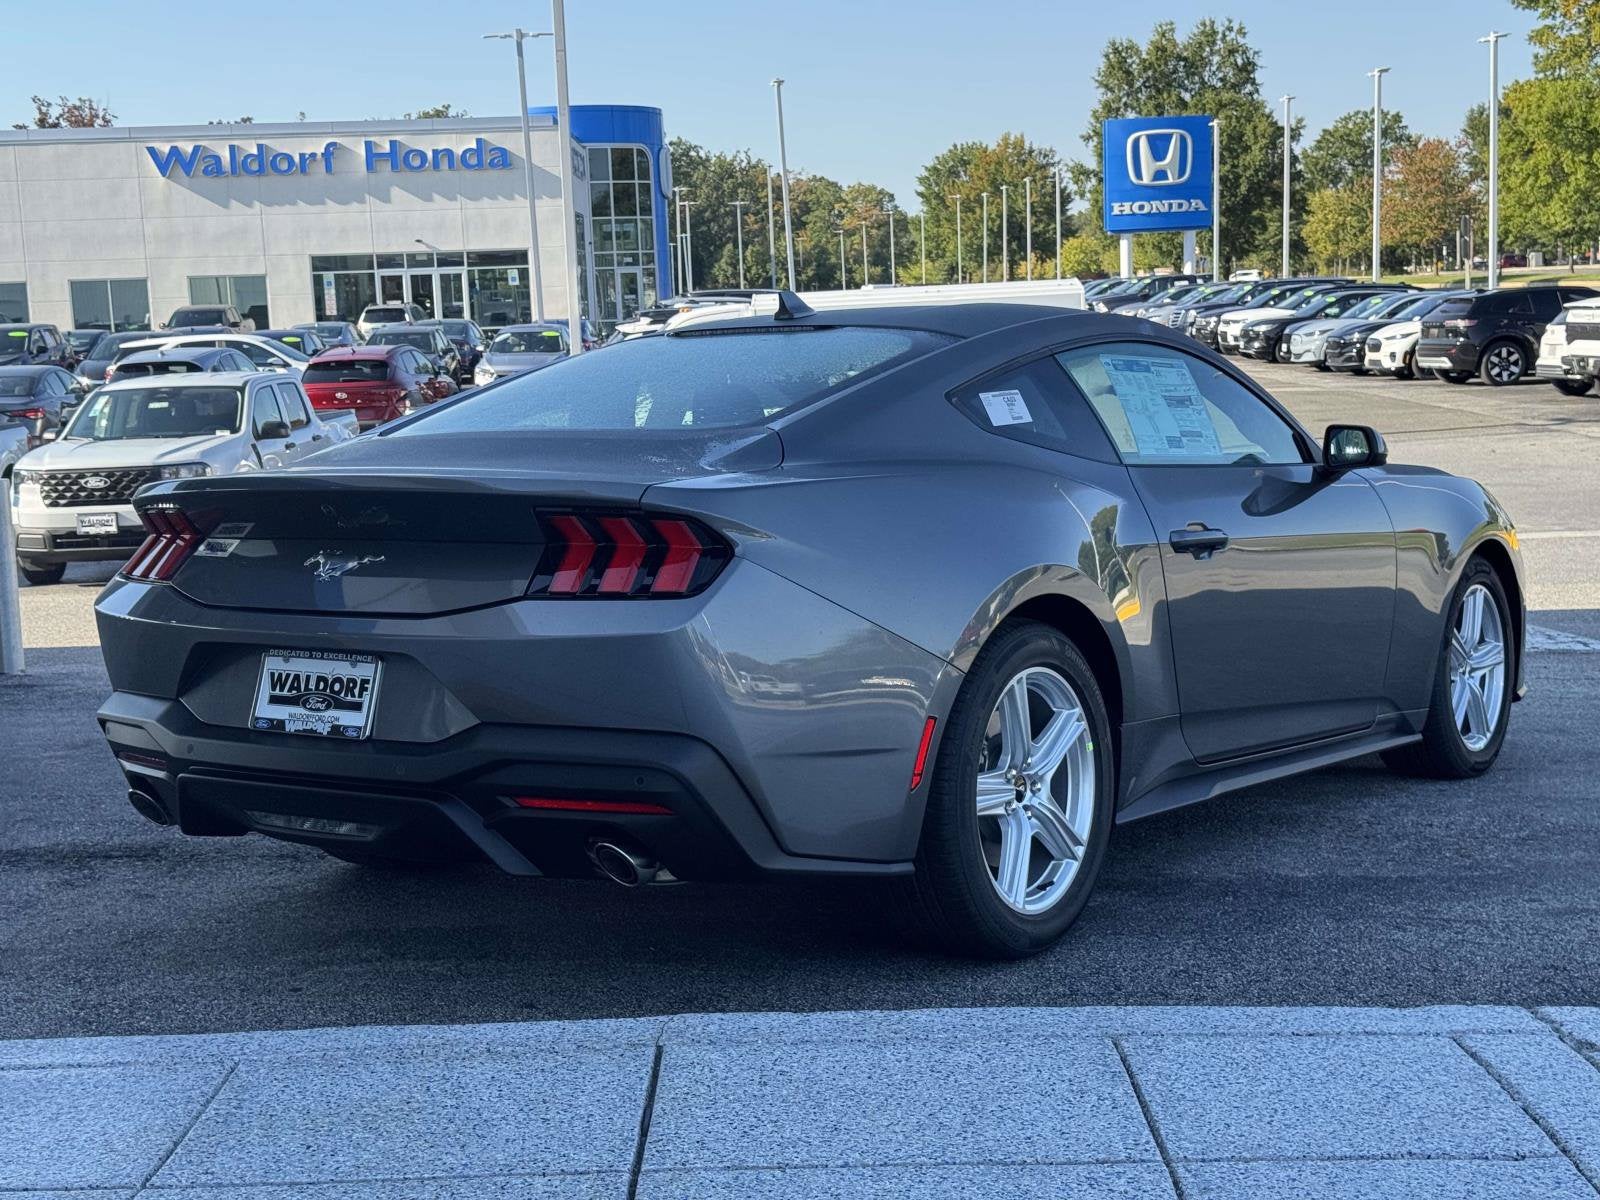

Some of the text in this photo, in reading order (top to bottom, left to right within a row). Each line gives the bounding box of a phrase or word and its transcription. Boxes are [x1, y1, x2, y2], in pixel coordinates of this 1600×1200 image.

[146, 137, 513, 178] Waldorf Honda
[1110, 199, 1208, 216] HONDA
[269, 649, 310, 658] DEDICATED
[269, 671, 370, 699] WALDORF
[306, 696, 328, 710] Ford
[288, 712, 340, 723] WALDORFFORD.COM
[285, 719, 333, 735] WALDORF
